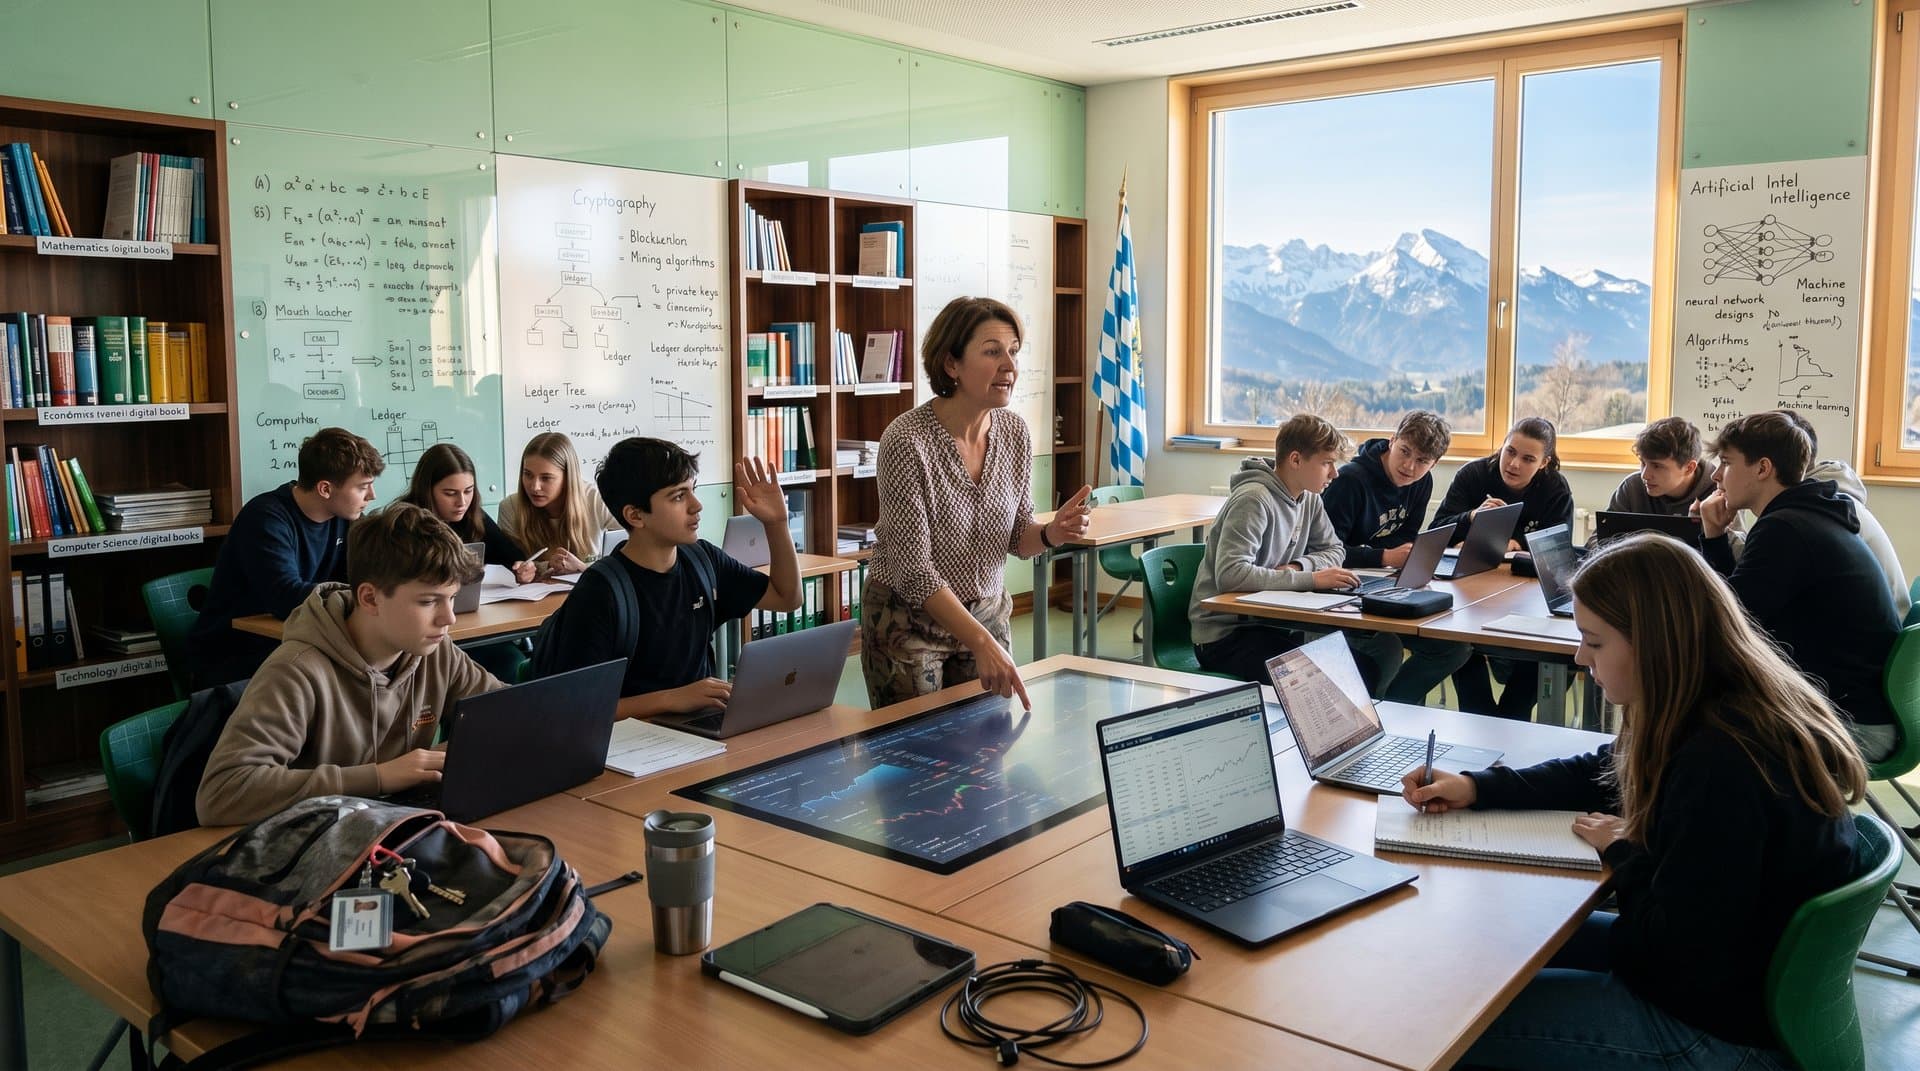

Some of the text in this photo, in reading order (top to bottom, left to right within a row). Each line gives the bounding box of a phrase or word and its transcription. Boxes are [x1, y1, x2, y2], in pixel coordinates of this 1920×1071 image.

[1690, 173, 1798, 198] Artificial Intel
[572, 188, 657, 218] Cryptography
[1770, 189, 1851, 209] Intelligence
[41, 241, 109, 253] Mathematics
[631, 250, 662, 271] Mining
[665, 253, 716, 272] algorithms
[1796, 278, 1846, 290] Machine
[666, 285, 719, 301] private keys
[1685, 294, 1765, 307] neural network
[1802, 294, 1846, 308] learning
[1714, 309, 1755, 323] designs
[1685, 333, 1750, 352] Algorithms
[603, 350, 632, 366] Ledger
[524, 382, 587, 403] Ledger Tree
[371, 408, 407, 426] Ledger
[1777, 400, 1850, 417] Machine learning
[526, 417, 562, 432] Ledger
[52, 540, 101, 554] Computer
[102, 537, 139, 550] Science
[172, 532, 200, 543] books
[60, 666, 118, 683] Technology
